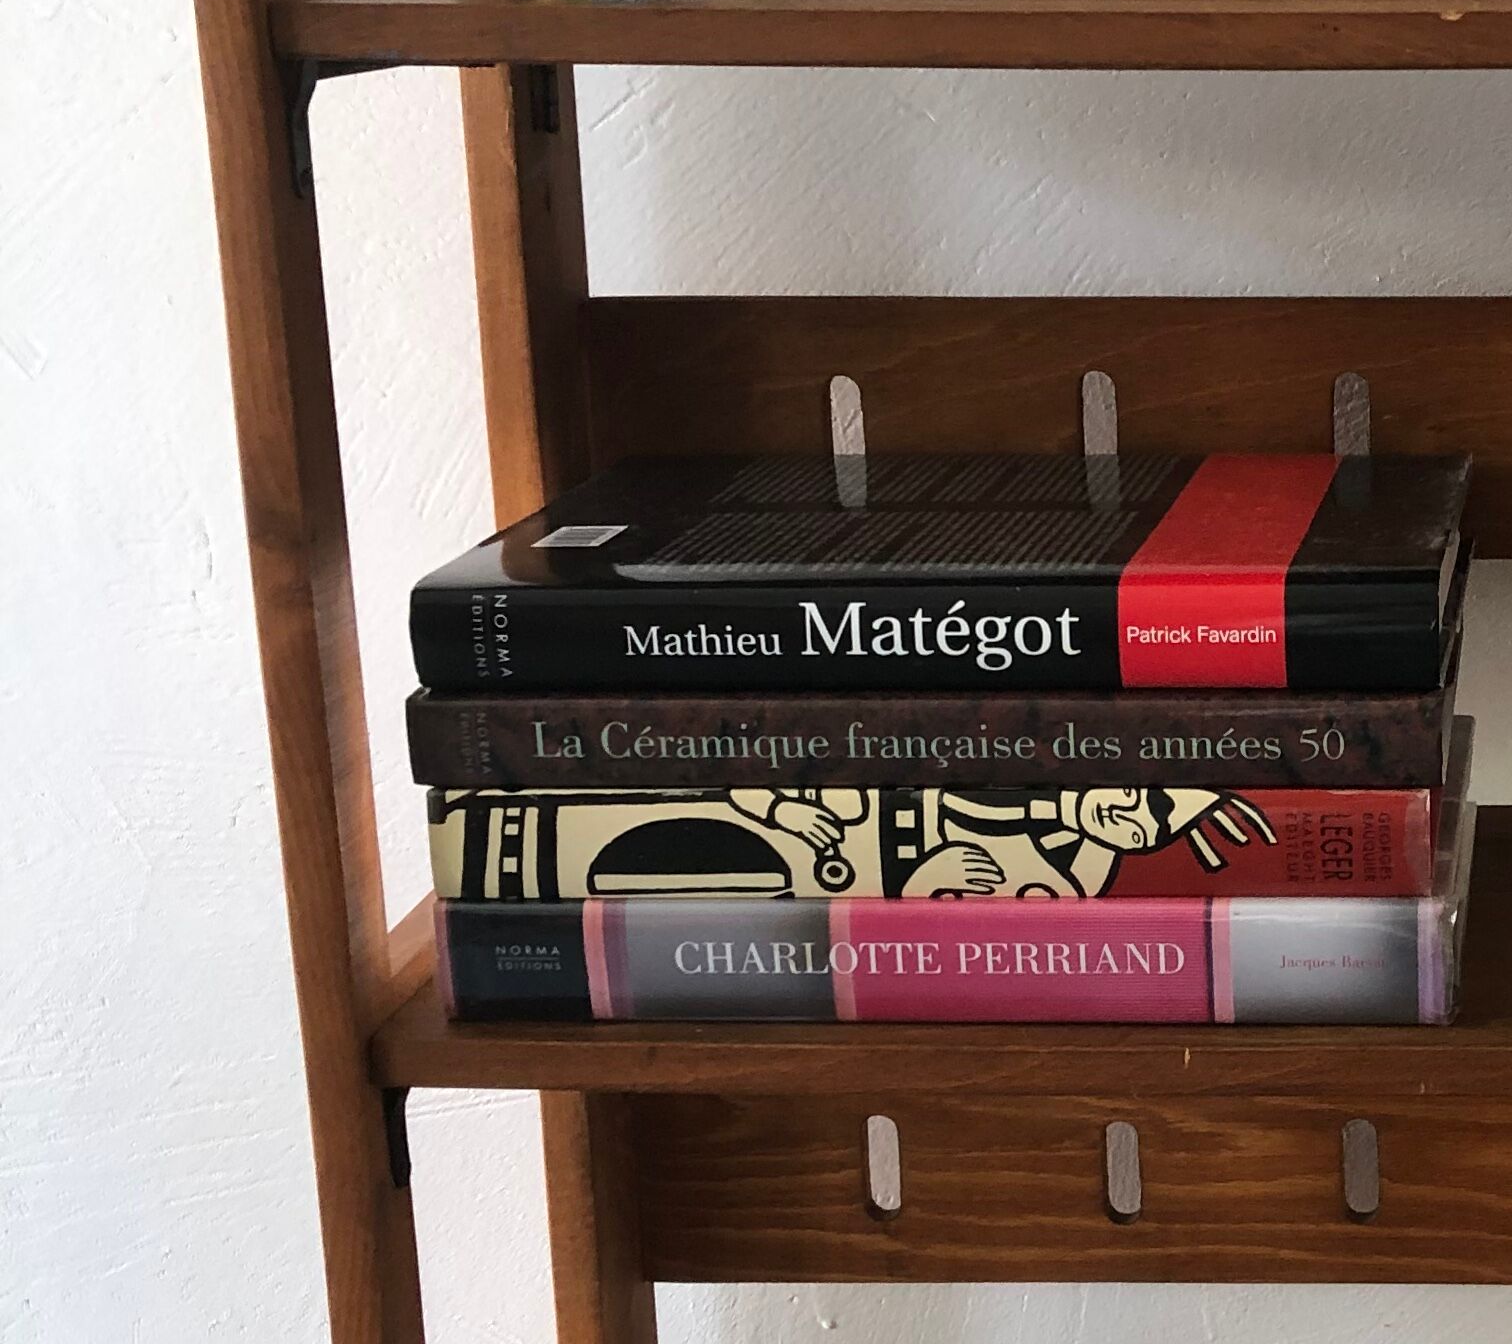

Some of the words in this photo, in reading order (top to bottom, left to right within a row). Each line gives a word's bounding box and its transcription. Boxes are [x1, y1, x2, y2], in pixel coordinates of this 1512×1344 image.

[494, 594, 513, 678] NORMA
[624, 625, 782, 656] Mathieu
[798, 599, 1081, 672] Matégot
[1126, 625, 1192, 645] Patrick
[1197, 625, 1277, 645] Favardin
[530, 721, 585, 758] La
[600, 721, 830, 768] Céramique
[845, 721, 1036, 768] française
[1052, 722, 1122, 760] des
[1140, 727, 1282, 760] années
[1299, 728, 1346, 762] 50
[1378, 812, 1392, 881] GEORGES
[495, 945, 561, 956] NORMA
[673, 942, 943, 975] CHARLOTTE
[956, 942, 1187, 975] PERRIAND
[1280, 955, 1336, 971] Jacques
